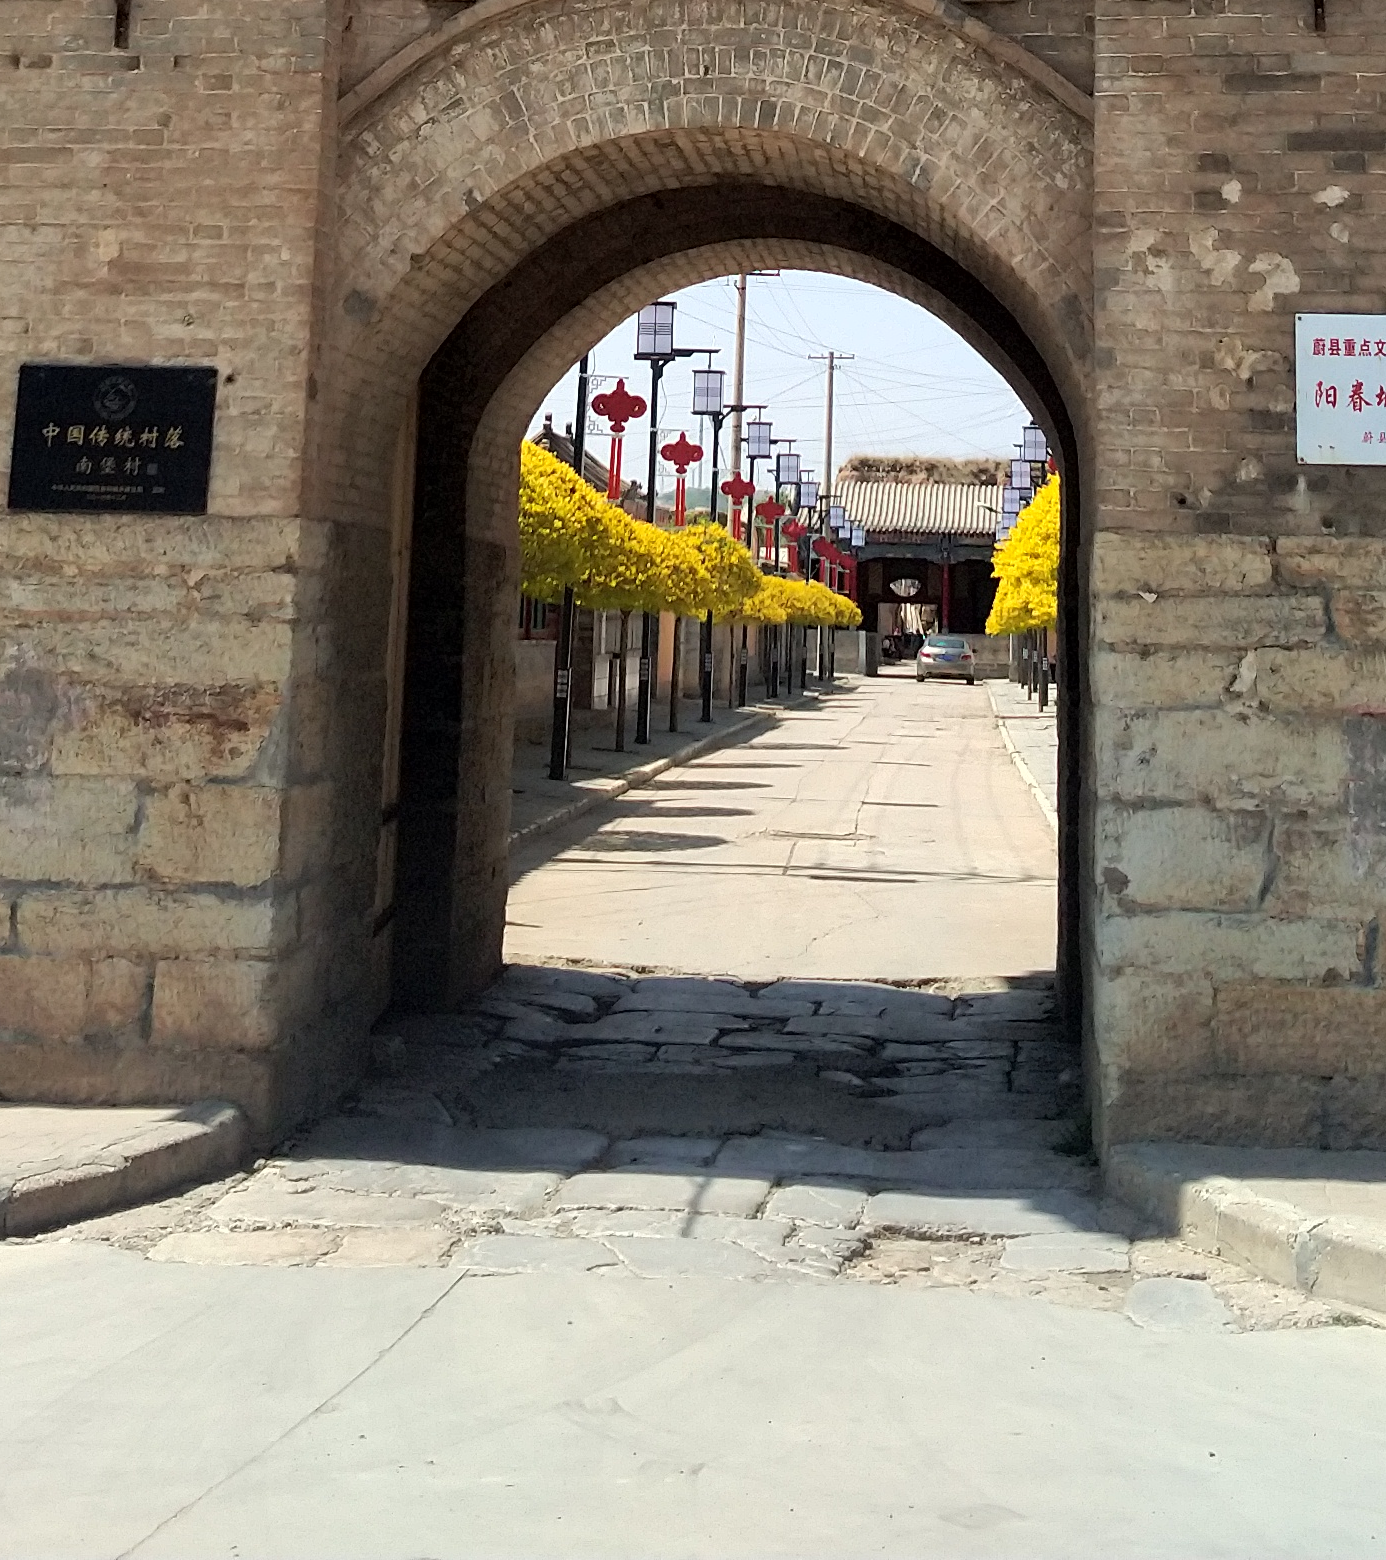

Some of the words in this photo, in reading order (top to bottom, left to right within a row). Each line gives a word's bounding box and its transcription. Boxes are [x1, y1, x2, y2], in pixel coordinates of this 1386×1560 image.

[42, 422, 185, 448] 中国传统村落
[75, 456, 142, 476] 南堡村
